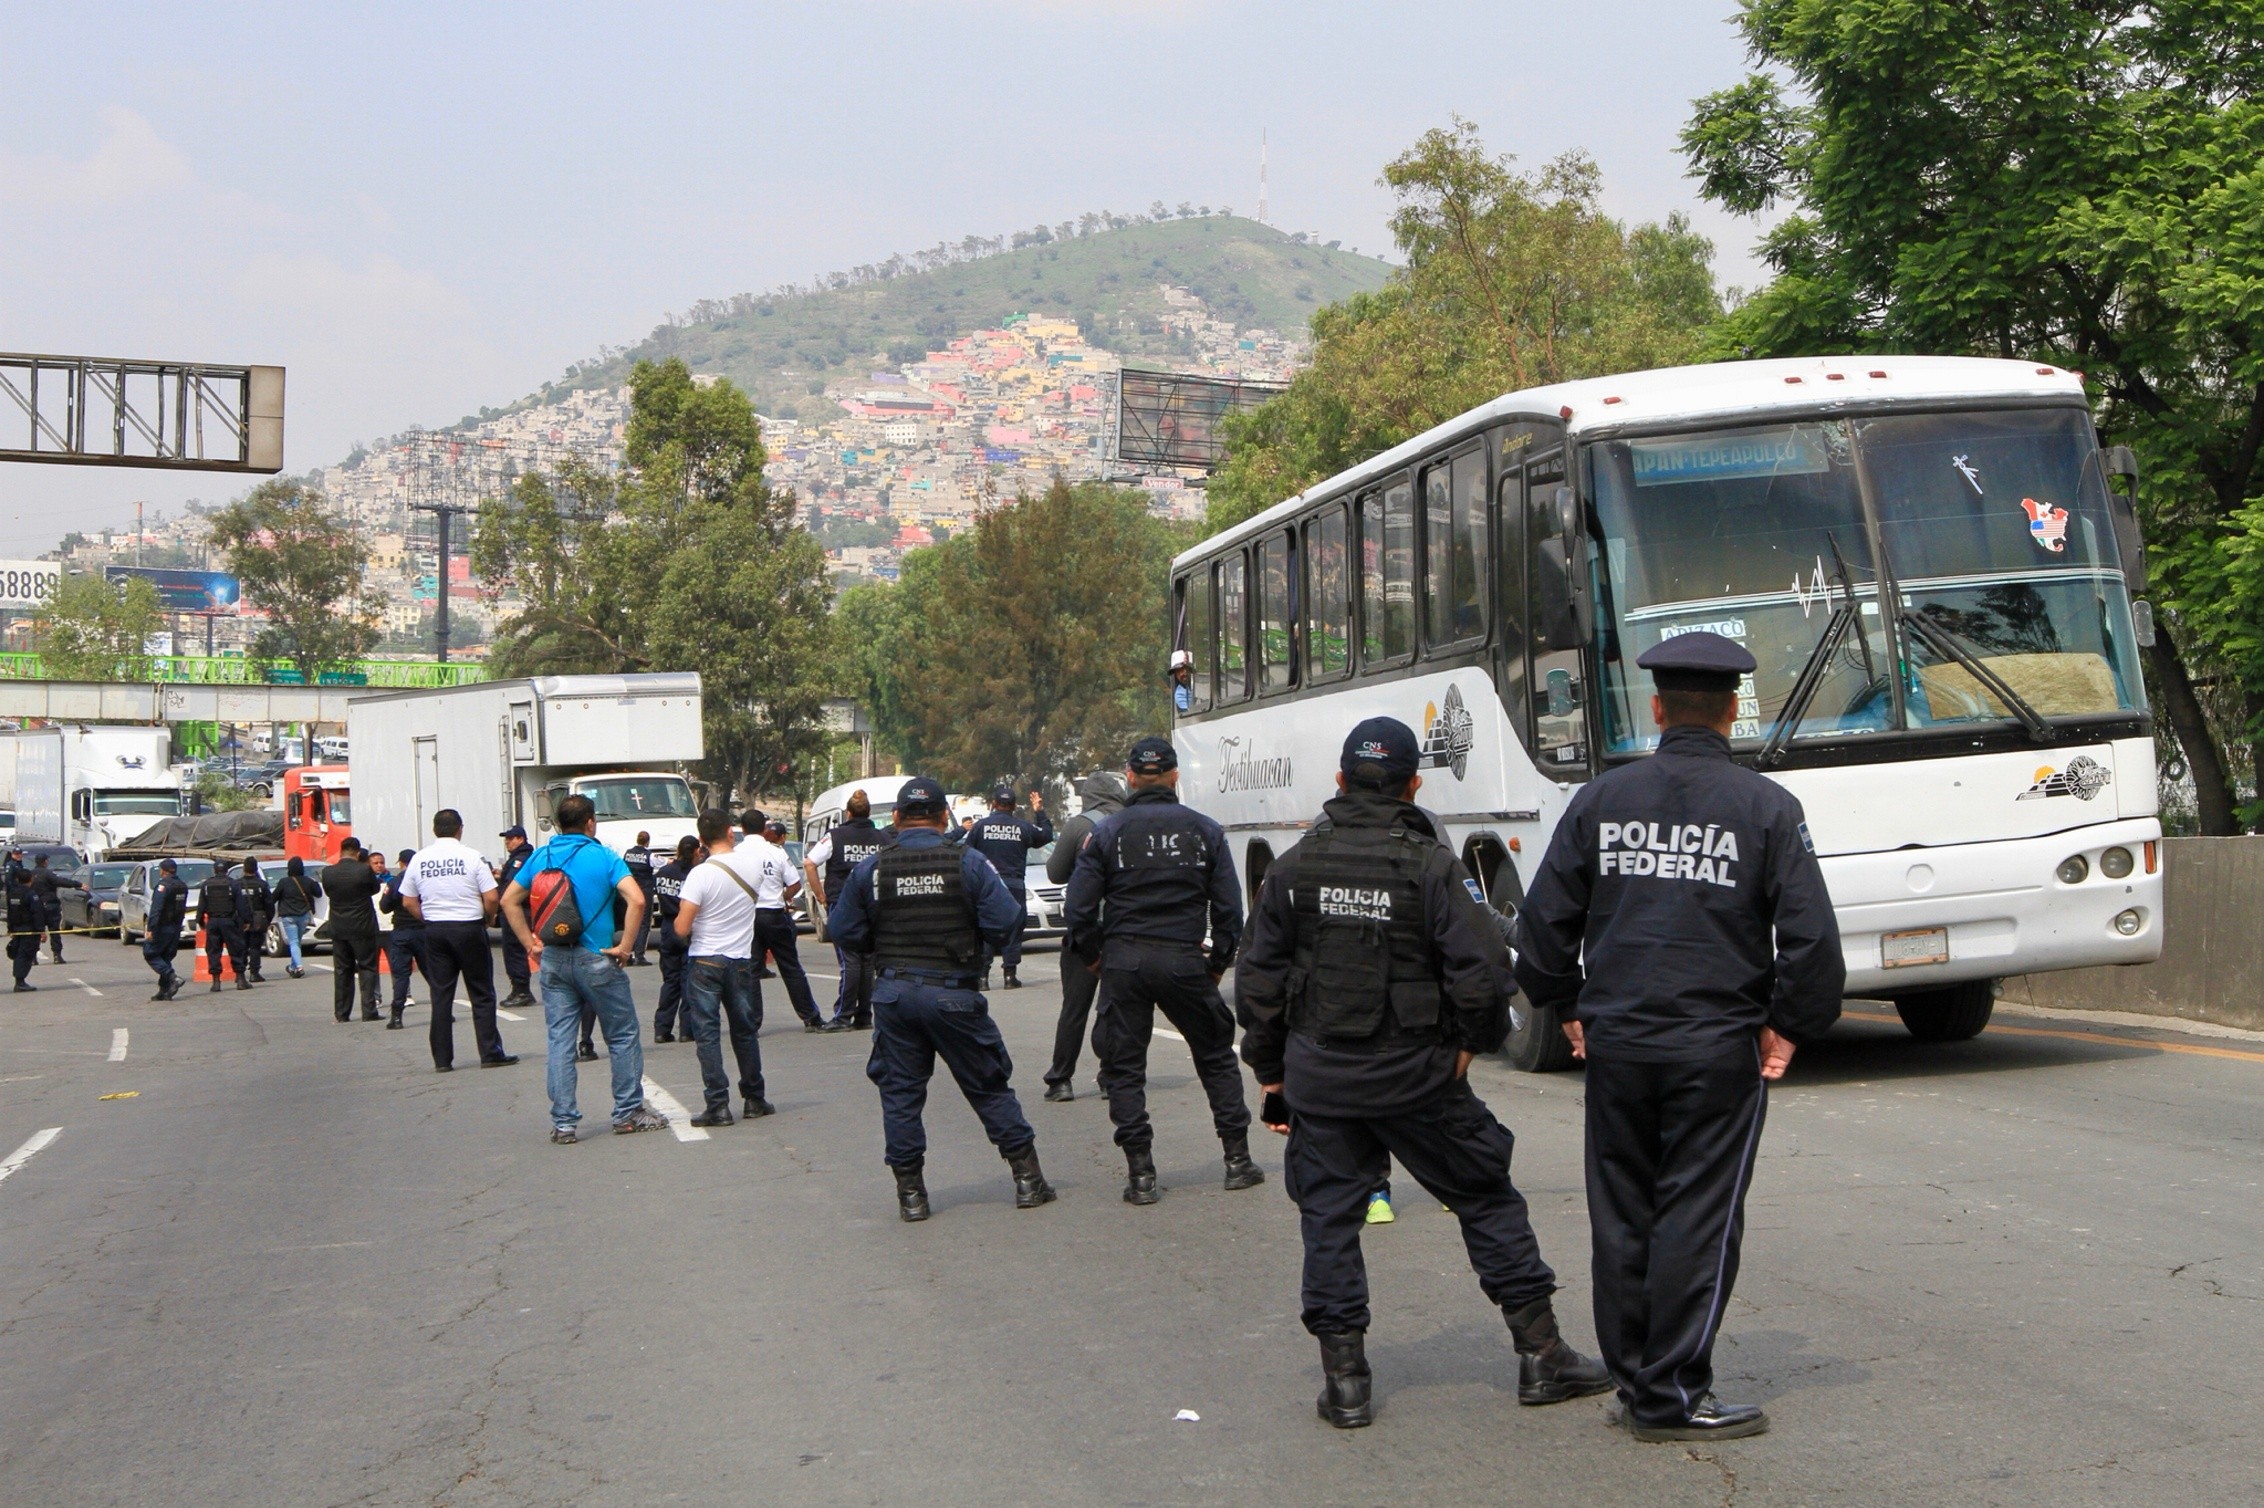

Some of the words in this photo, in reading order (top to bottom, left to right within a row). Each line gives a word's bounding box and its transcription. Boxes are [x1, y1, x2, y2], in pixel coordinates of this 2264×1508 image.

[1363, 741, 1382, 751] CNS
[1218, 736, 1294, 793] Teotihuacan
[984, 824, 1021, 835] POLICÍA
[984, 833, 1021, 841] FEDERAL
[1600, 820, 1739, 862] POLICÍA
[420, 867, 467, 879] FEDERAL
[1600, 851, 1736, 888] FEDERAL
[896, 874, 944, 887] POLICÍA
[896, 885, 943, 896] FEDERAL
[1320, 902, 1391, 920] FEDERAL
